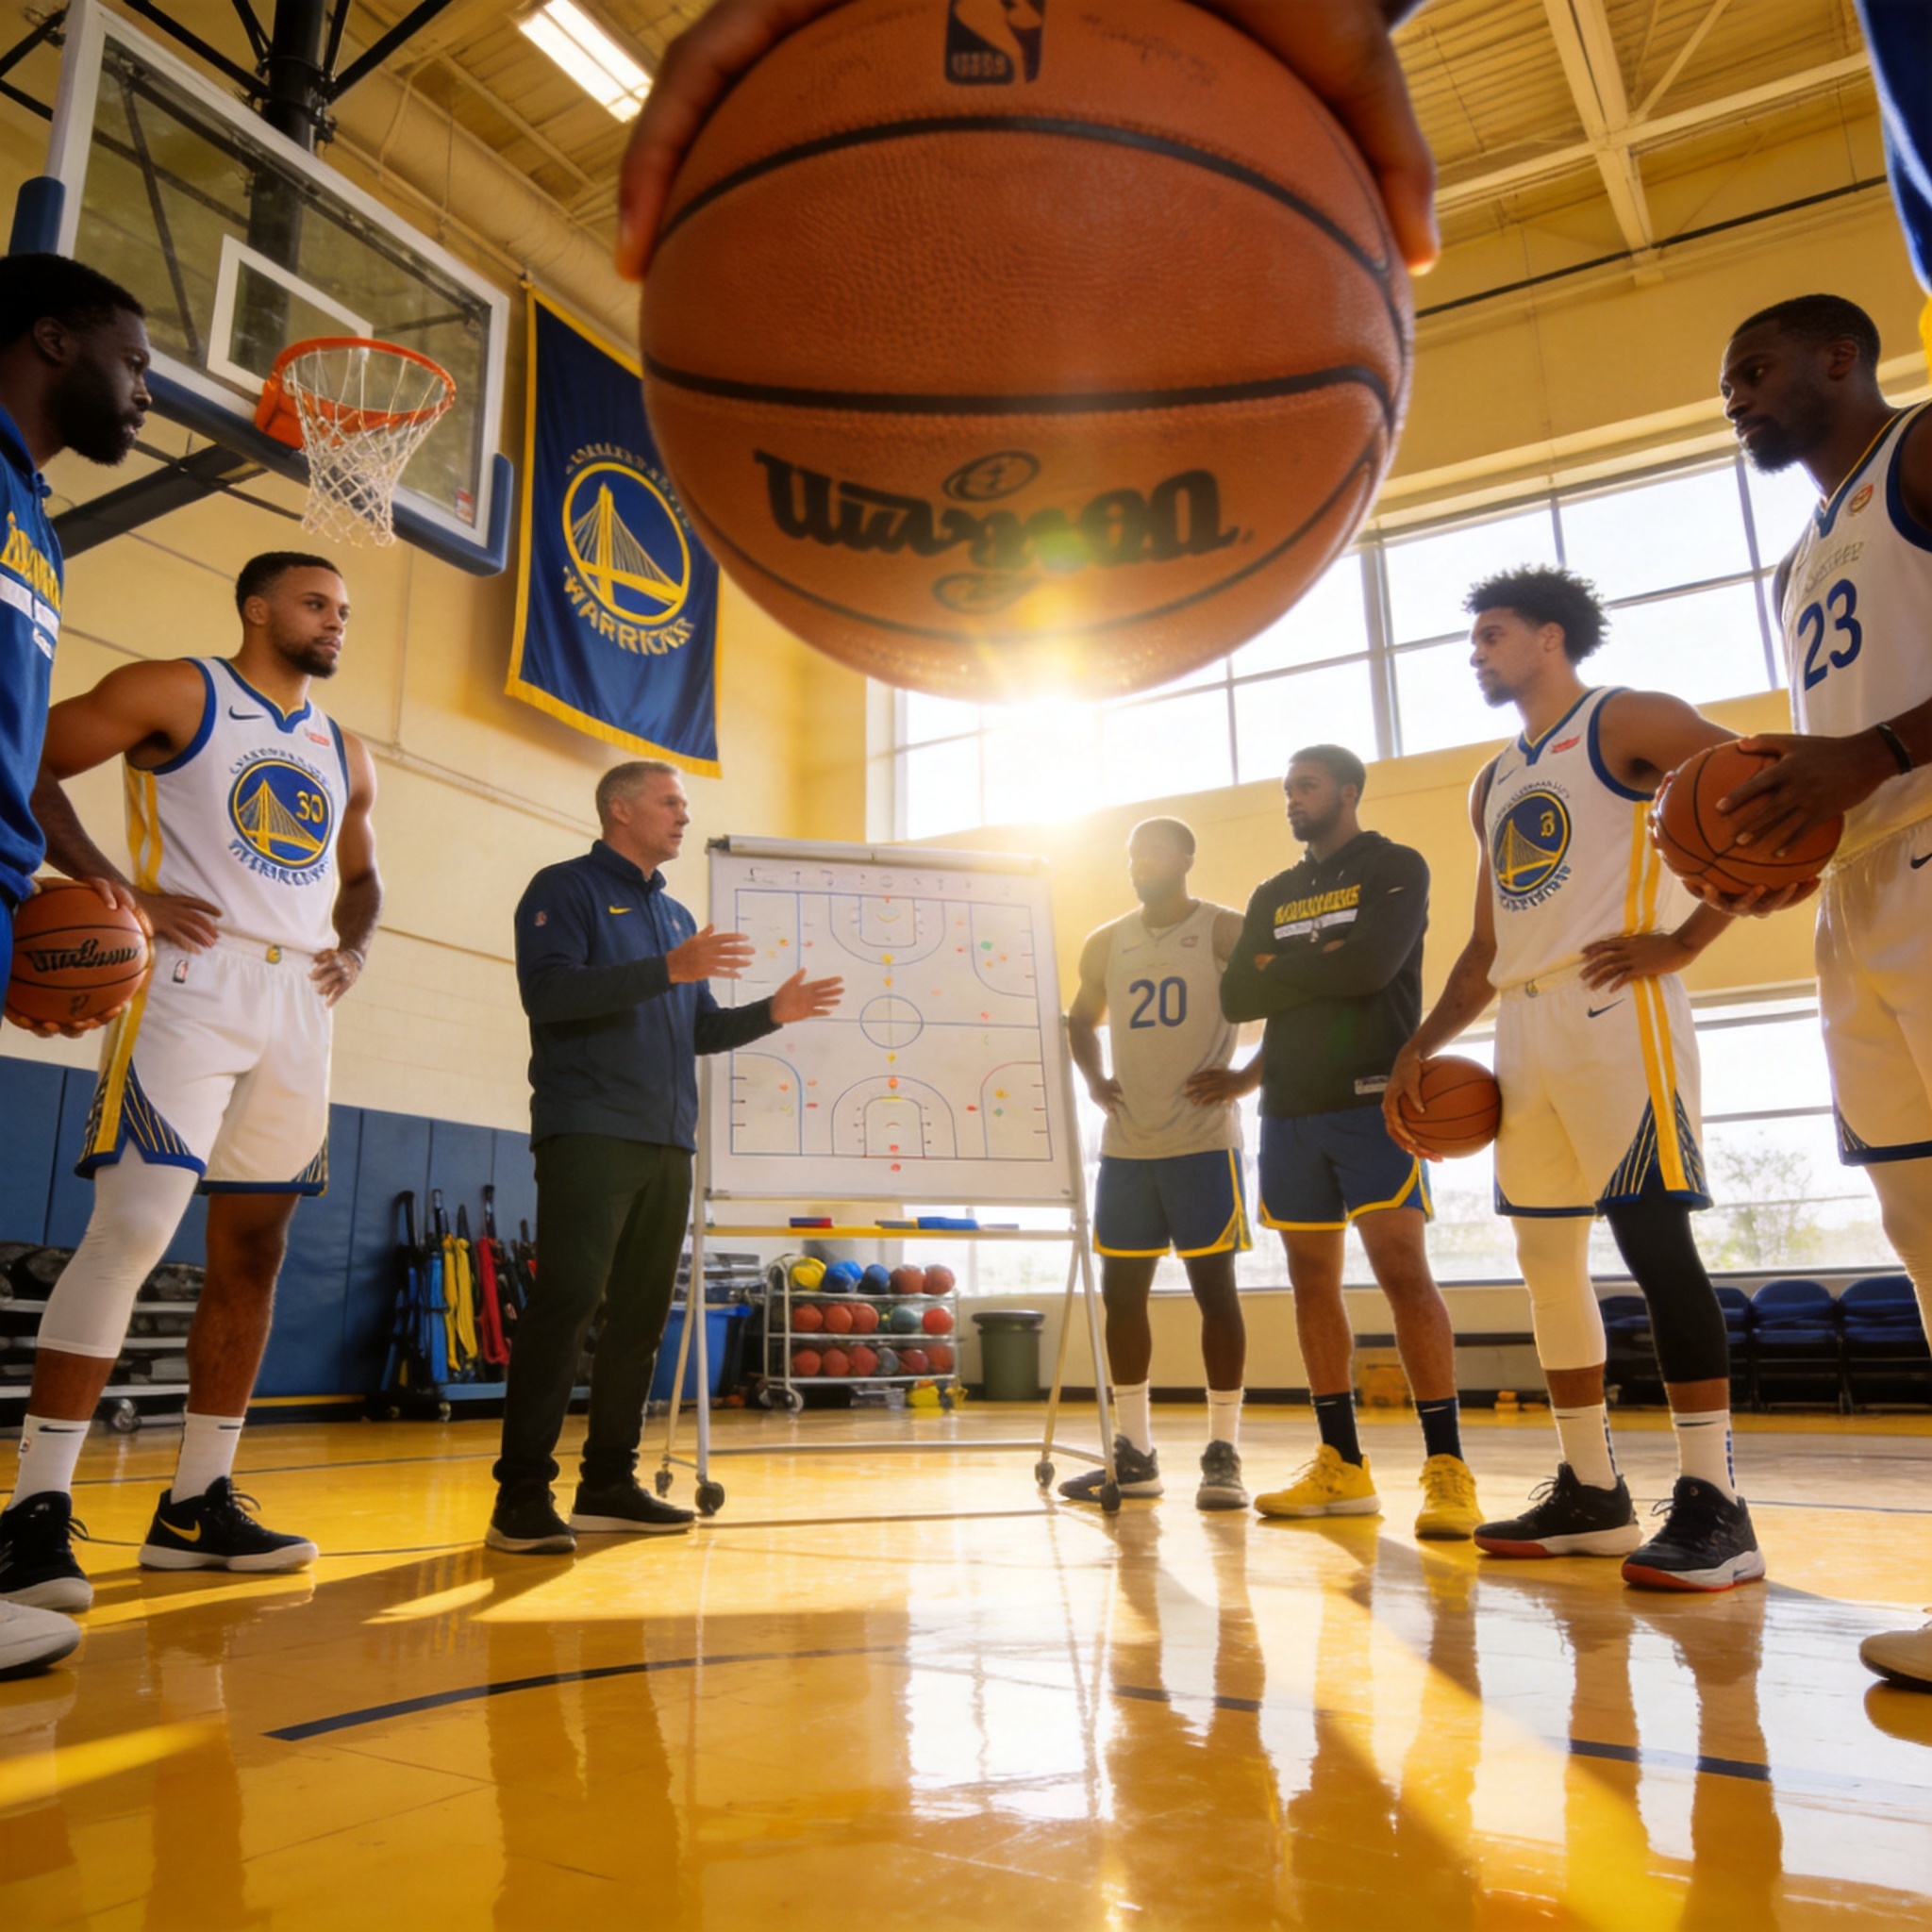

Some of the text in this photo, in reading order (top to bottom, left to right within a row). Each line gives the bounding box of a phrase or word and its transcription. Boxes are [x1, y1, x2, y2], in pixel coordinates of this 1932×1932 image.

[1797, 578, 1862, 691] 23
[296, 791, 324, 824] 30
[1129, 975, 1188, 1029] 20
